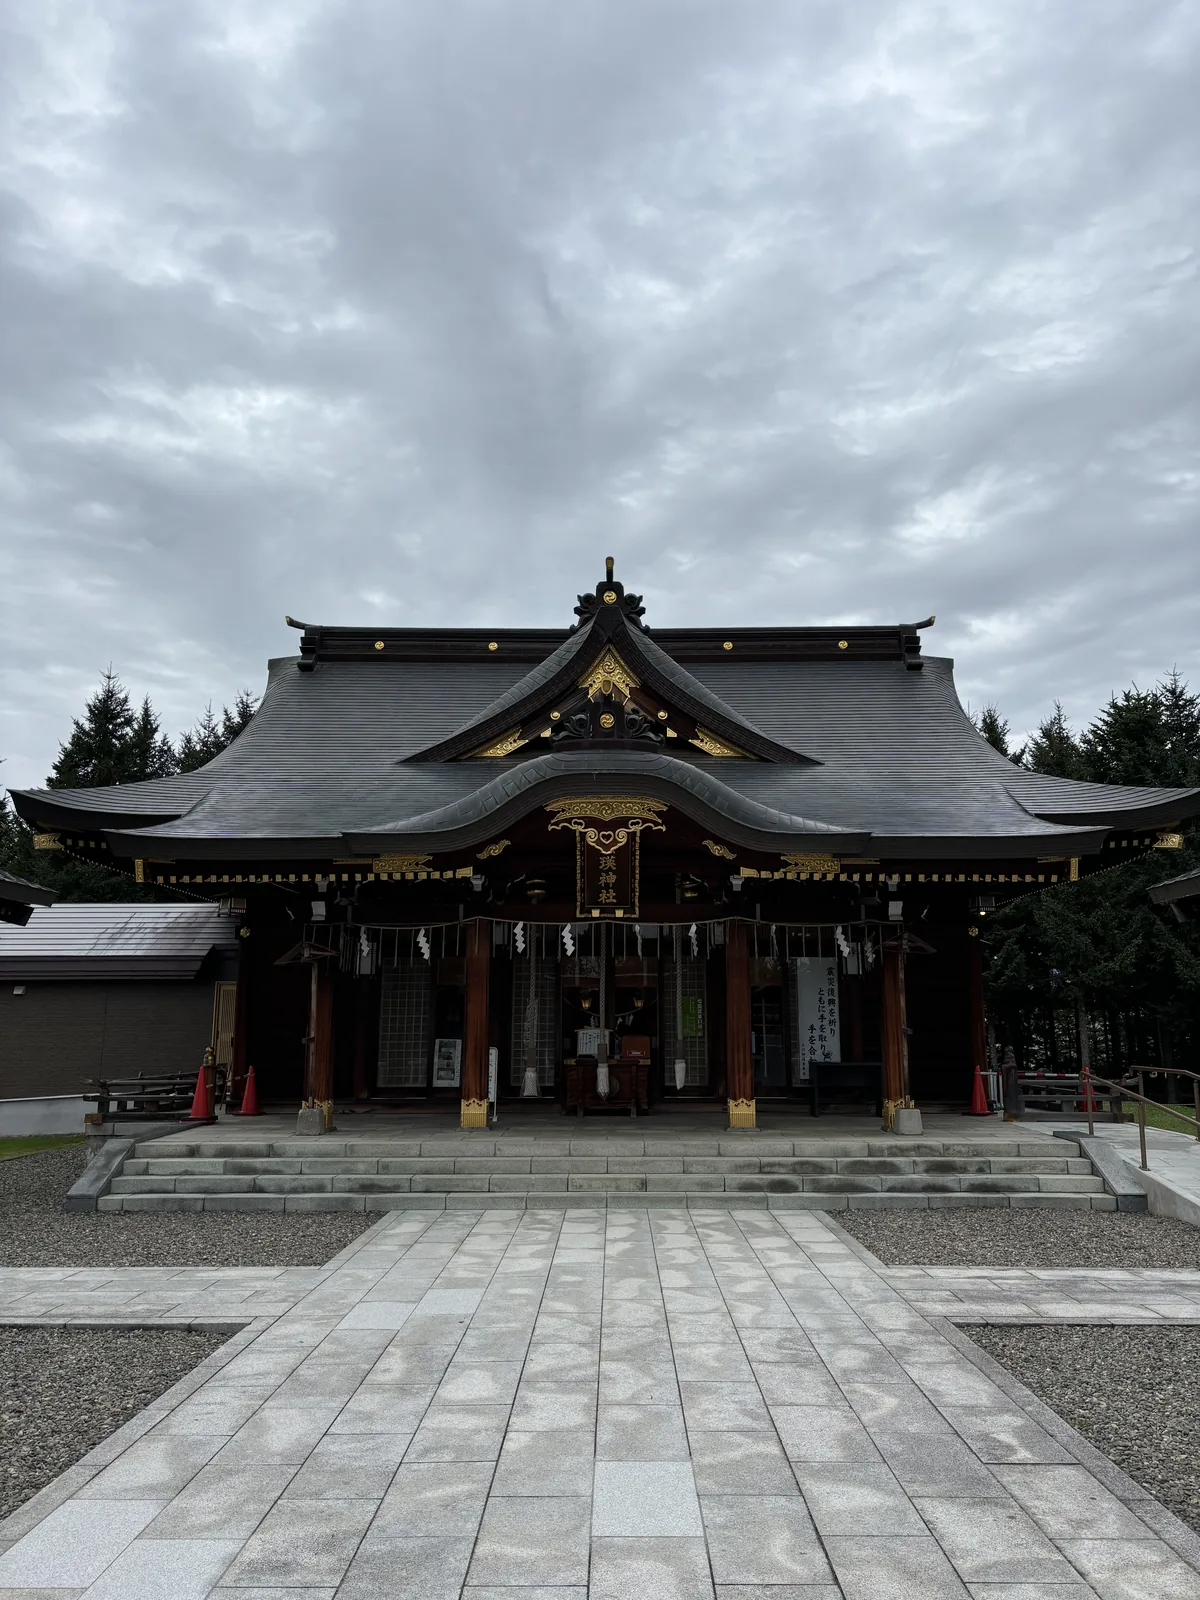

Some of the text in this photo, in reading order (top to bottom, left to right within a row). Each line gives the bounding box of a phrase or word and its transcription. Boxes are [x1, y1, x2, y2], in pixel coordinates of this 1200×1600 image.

[597, 851, 617, 904] 瑛神社
[818, 988, 828, 1051] ともに手を取り
[826, 966, 837, 1037] 震災復興を祈り
